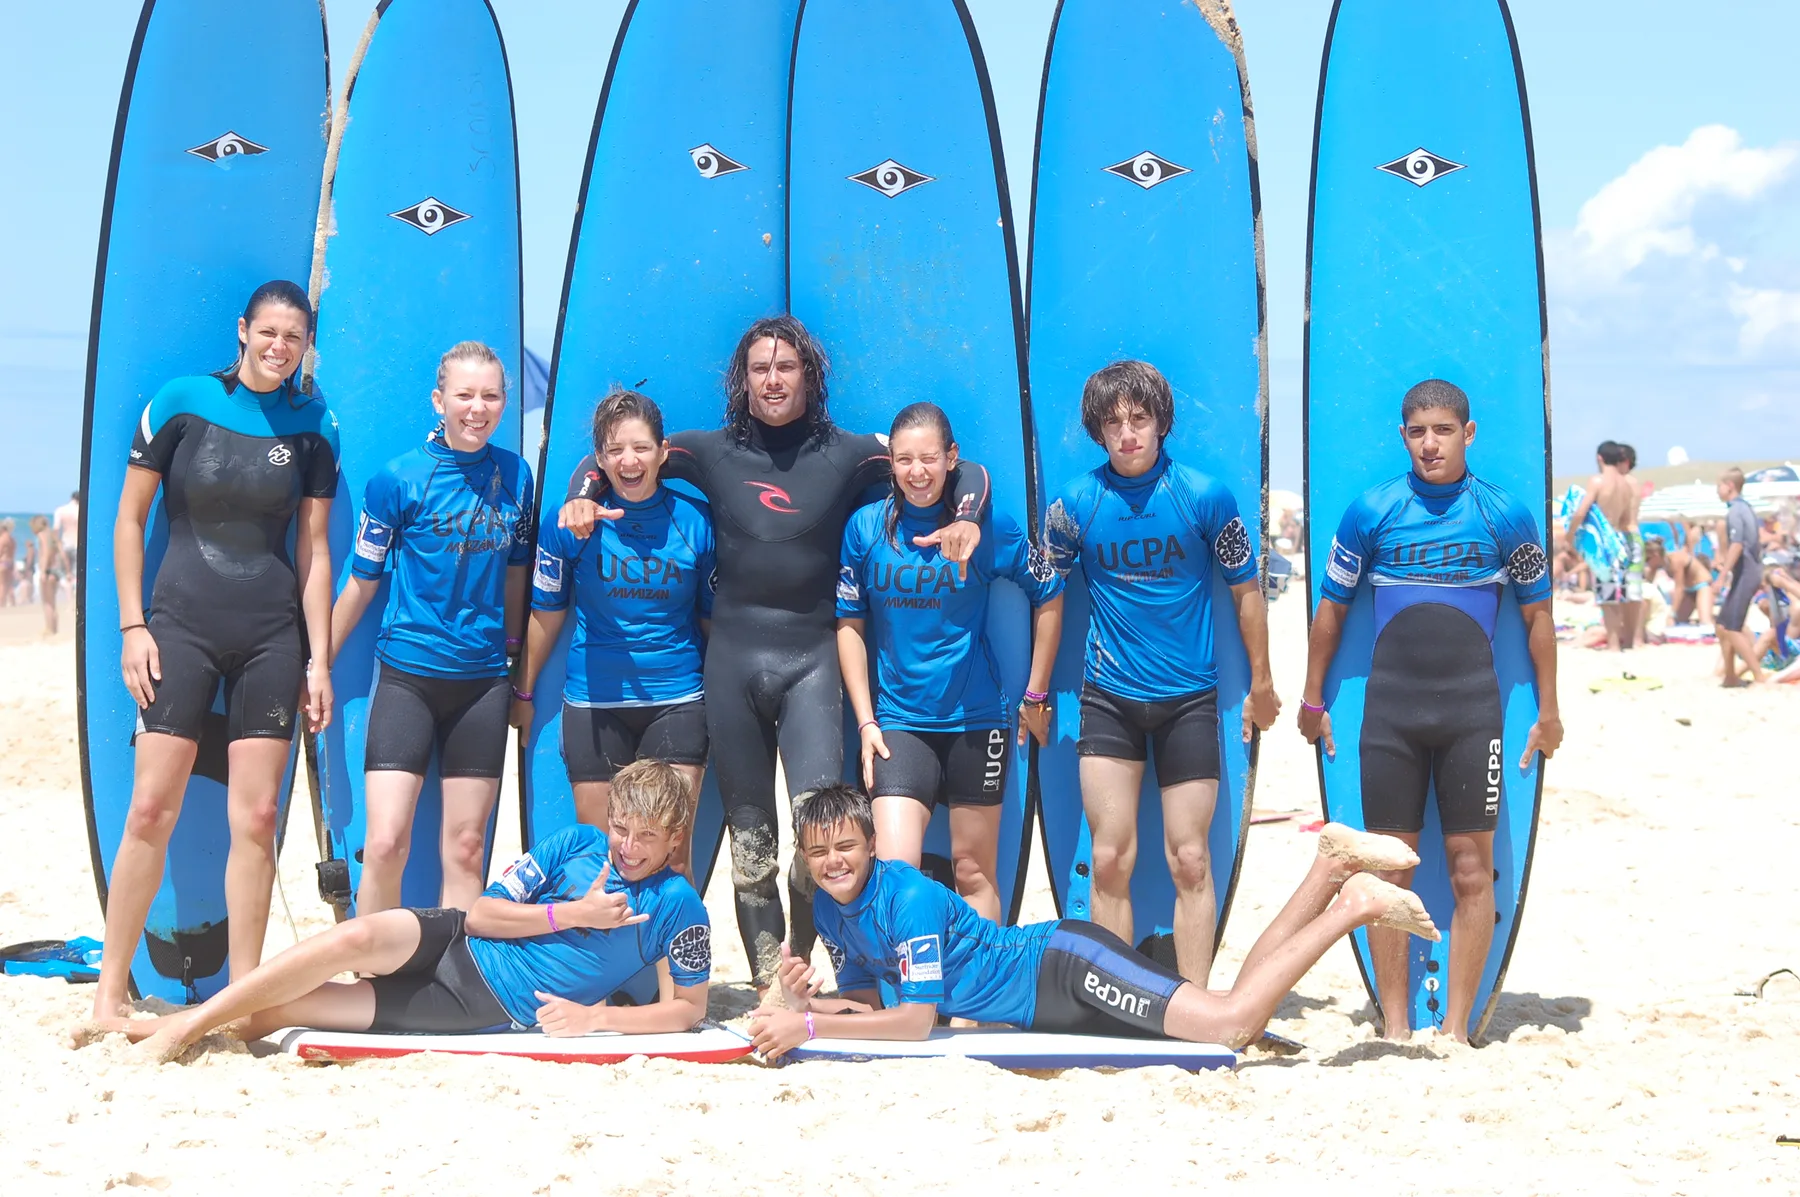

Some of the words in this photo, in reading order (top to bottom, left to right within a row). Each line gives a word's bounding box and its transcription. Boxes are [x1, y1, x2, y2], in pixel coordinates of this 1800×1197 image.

[432, 508, 507, 537] UCPA
[1096, 534, 1186, 571] UCPA
[1393, 542, 1484, 569] UCPA
[596, 554, 683, 585] UCPA
[873, 562, 957, 594] UCPA
[607, 586, 670, 600] MIMIZAN
[883, 596, 941, 610] MIMIZAN
